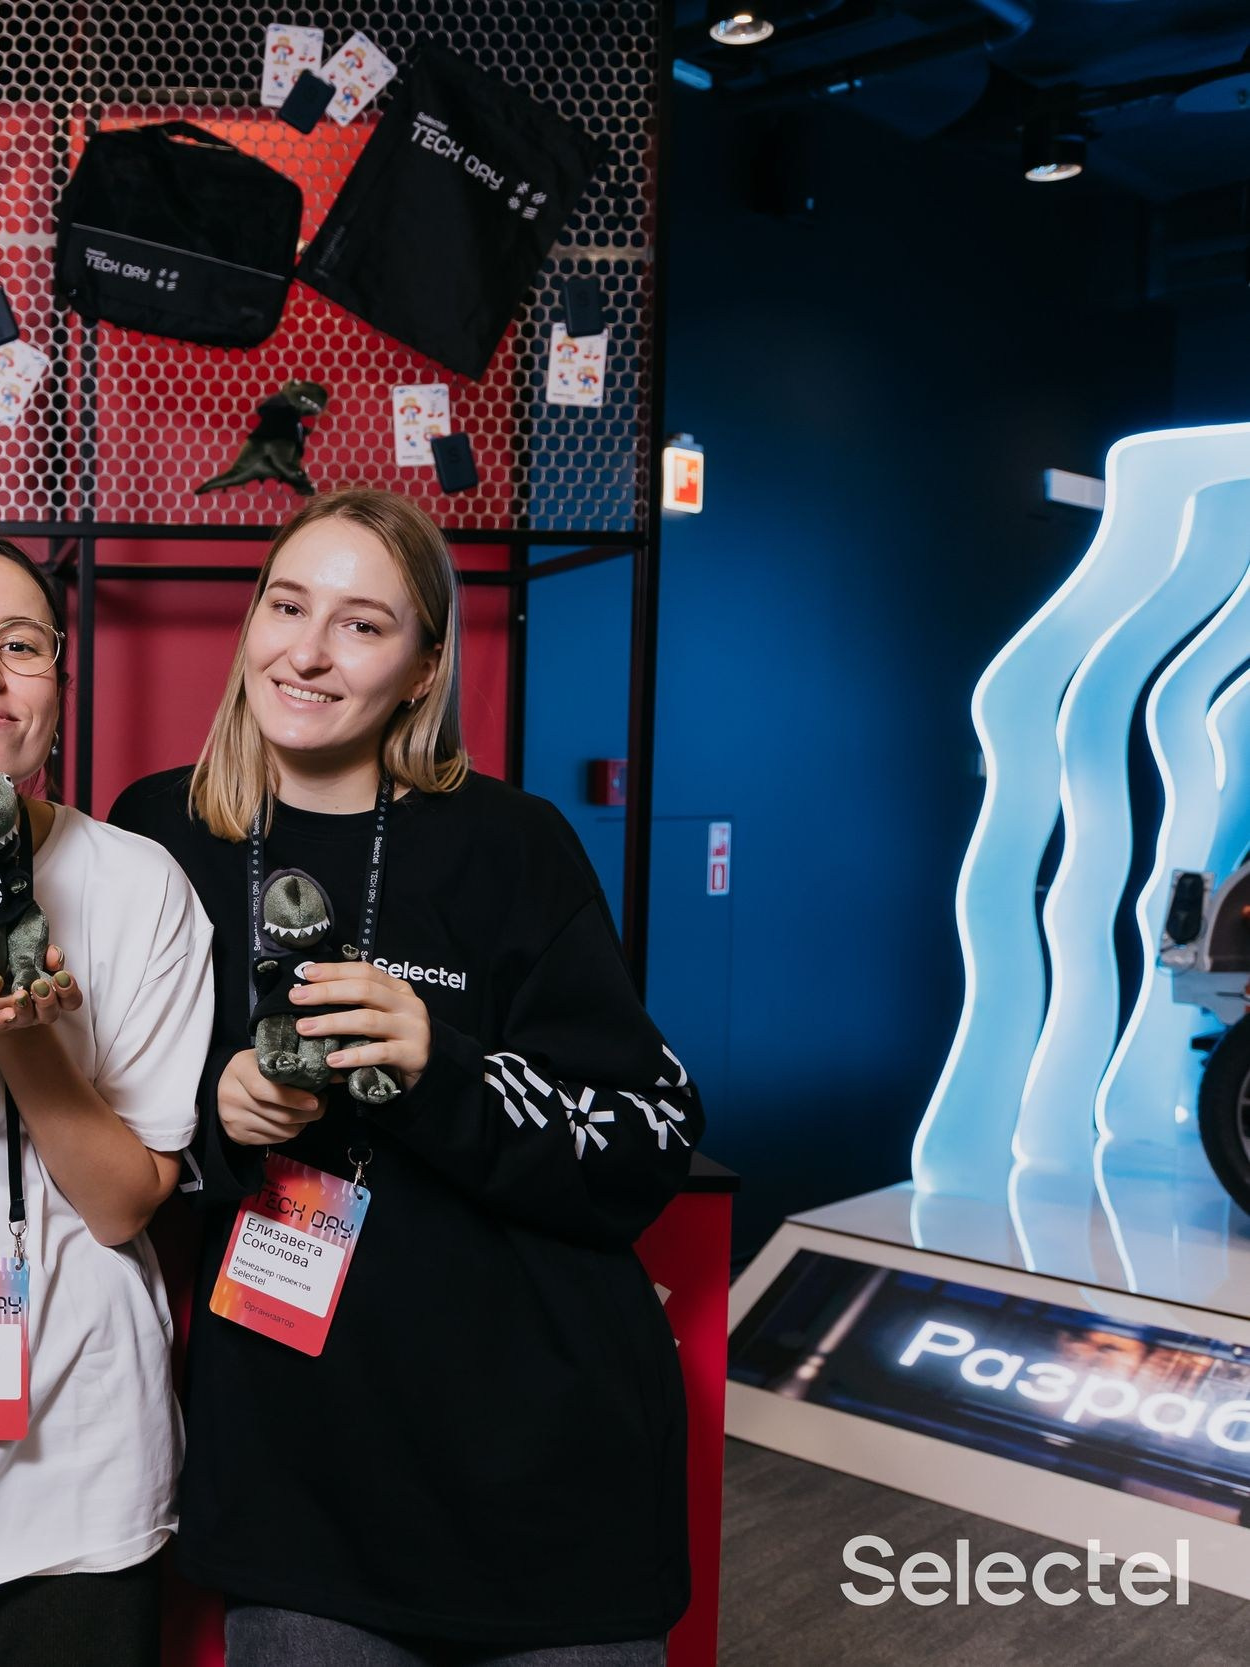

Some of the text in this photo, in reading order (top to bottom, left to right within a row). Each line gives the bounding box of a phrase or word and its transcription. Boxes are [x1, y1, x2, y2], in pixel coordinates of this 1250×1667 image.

[411, 121, 504, 191] TECH DAY
[84, 252, 120, 274] TECH
[372, 836, 383, 864] Selectel
[373, 957, 466, 991] Selectel
[256, 1188, 355, 1239] TECH DAY
[242, 1232, 309, 1268] Соколова
[246, 1217, 323, 1257] Елизавета
[232, 1266, 266, 1286] Selectel
[235, 1256, 311, 1291] Менеджер проектов
[244, 1301, 295, 1329] Организатор
[898, 1320, 1250, 1454] Разраб
